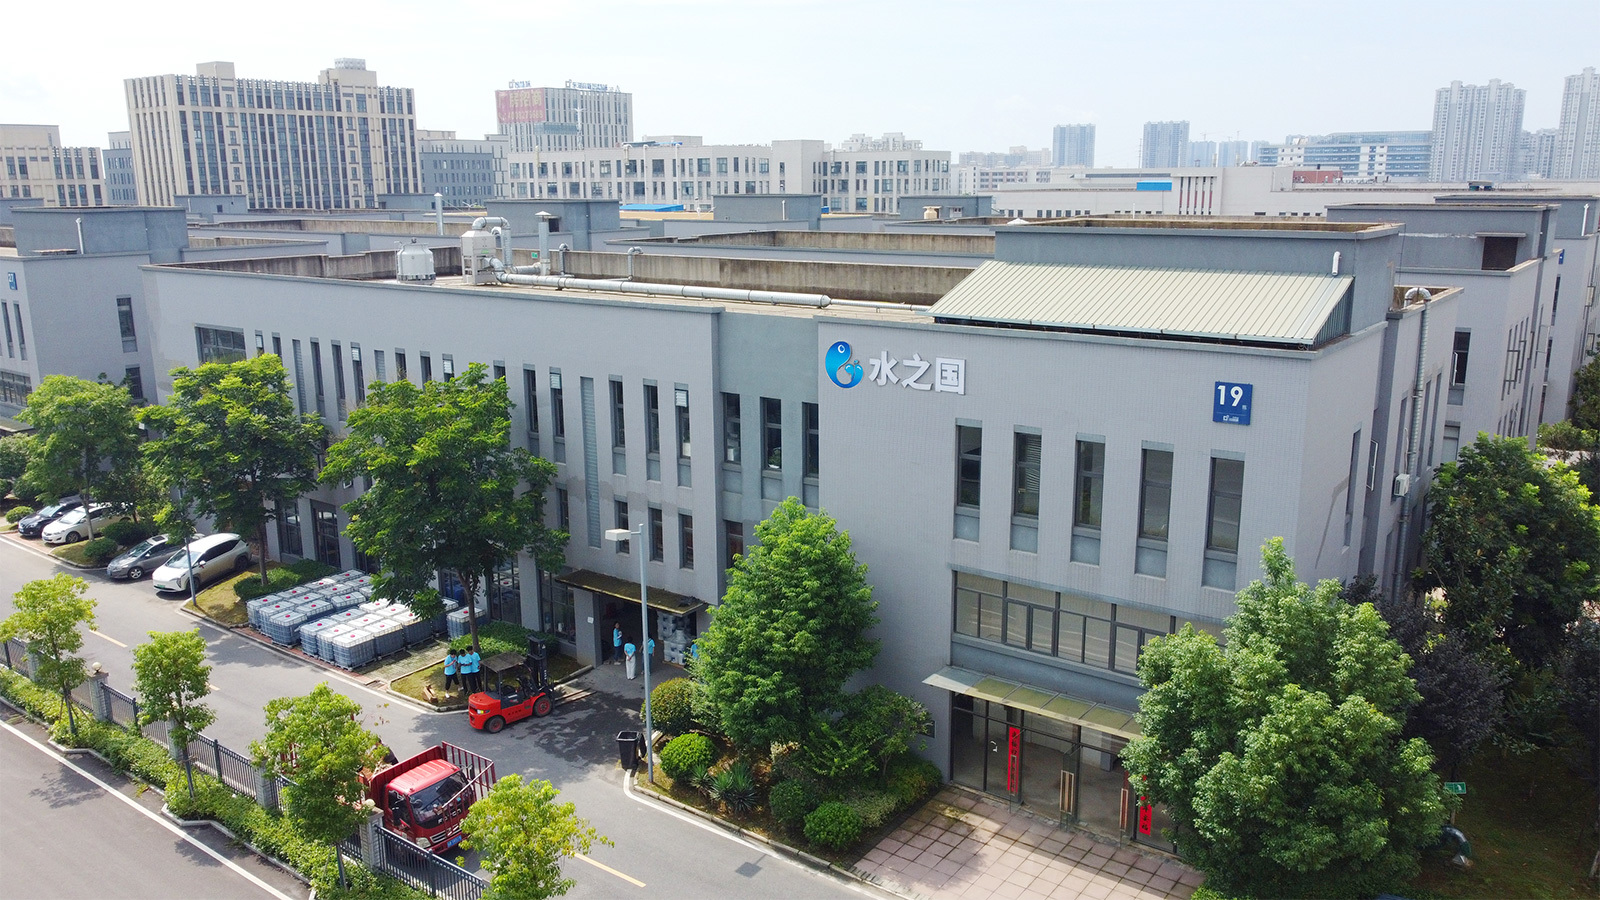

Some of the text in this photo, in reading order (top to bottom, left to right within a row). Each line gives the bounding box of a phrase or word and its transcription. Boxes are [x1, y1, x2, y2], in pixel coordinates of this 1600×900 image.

[868, 350, 966, 395] 水之国
[1217, 385, 1243, 407] 19
